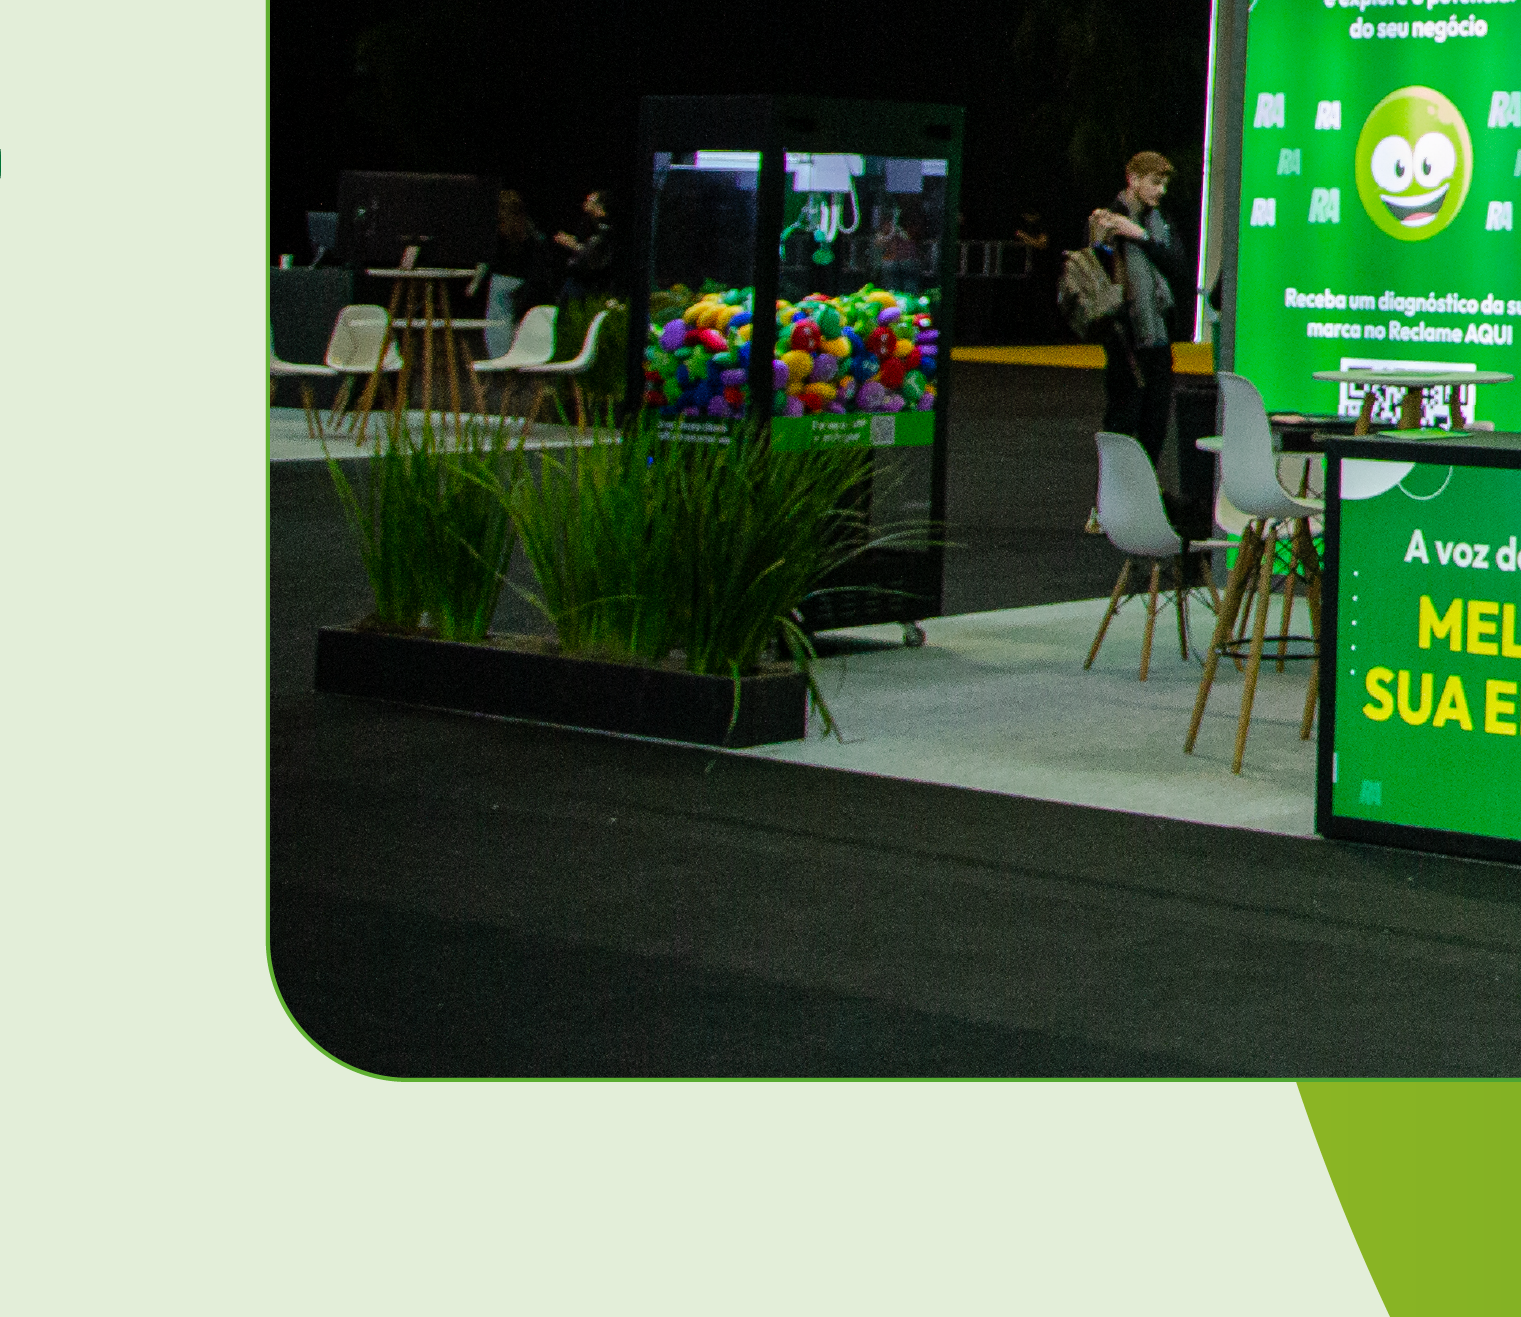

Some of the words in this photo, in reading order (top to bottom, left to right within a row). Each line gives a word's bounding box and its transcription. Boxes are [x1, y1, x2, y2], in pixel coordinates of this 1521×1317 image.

[1349, 17, 1373, 40] do
[1377, 22, 1409, 39] seu
[1412, 14, 1488, 43] negócio
[1253, 92, 1285, 129] RA
[1487, 90, 1521, 129] RA
[1308, 187, 1340, 224] RA
[1485, 200, 1513, 232] RA
[1285, 288, 1346, 311] Receba
[1348, 292, 1376, 312] um
[1378, 289, 1477, 318] diagnóstico
[1481, 295, 1504, 317] da
[1307, 321, 1361, 340] marca
[1364, 323, 1385, 341] no
[1388, 321, 1462, 344] Reclame
[1464, 324, 1513, 347] AQUI
[1403, 528, 1429, 565] A
[1434, 539, 1490, 570] voz
[1362, 665, 1474, 732] SUA
